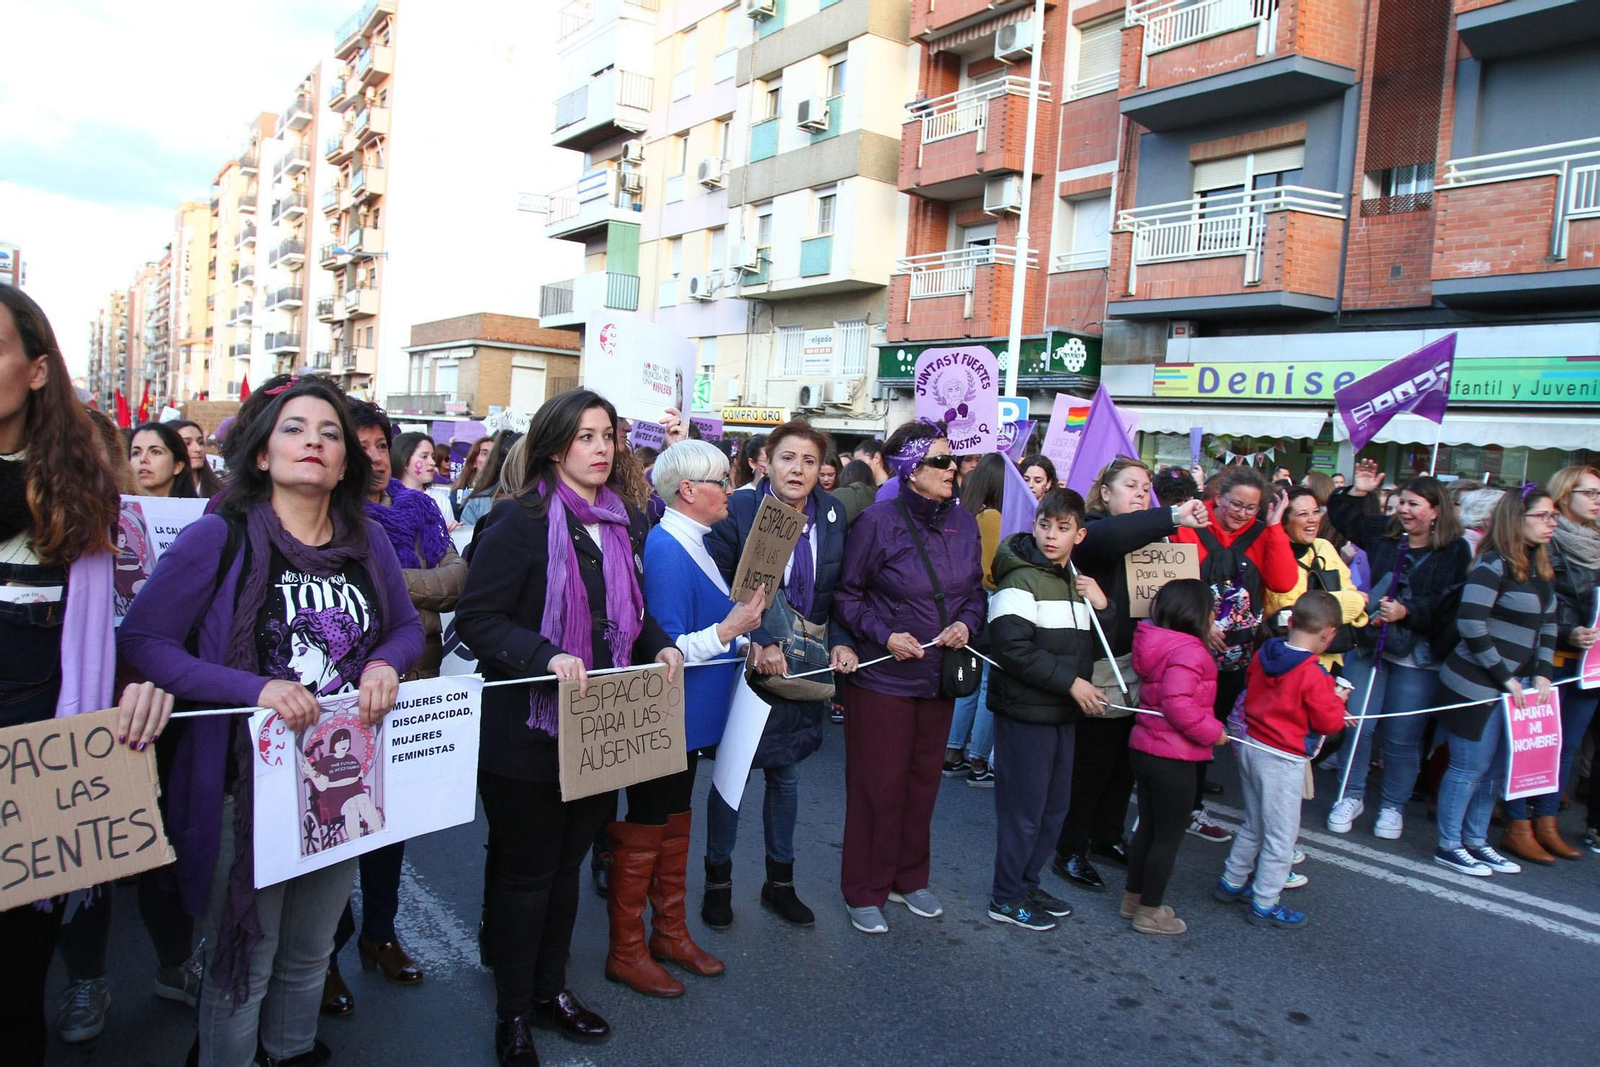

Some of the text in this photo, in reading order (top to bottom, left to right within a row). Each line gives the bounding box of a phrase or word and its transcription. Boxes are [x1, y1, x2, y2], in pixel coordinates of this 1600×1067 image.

[916, 353, 991, 396] JUNTAS Y FUERTES
[1198, 365, 1356, 395] Denise
[1450, 380, 1598, 399] fantil y Juveni
[723, 409, 781, 422] COMPRO ORO
[155, 526, 165, 534] LA
[281, 570, 299, 584] NOS
[274, 582, 370, 633] TODO
[392, 691, 469, 711] MUJERES CON
[392, 707, 473, 728] DISCAPACIDAD,
[1514, 703, 1555, 722] APUNTA
[580, 703, 662, 743] PARA LAS
[1529, 720, 1543, 735] MI
[391, 729, 443, 747] MUJERES
[1514, 733, 1559, 753] NOMBRE
[391, 743, 456, 764] FEMINISTAS
[579, 727, 672, 776] AUSENTES
[55, 775, 111, 811] LAS
[1, 807, 158, 891] SENTES
